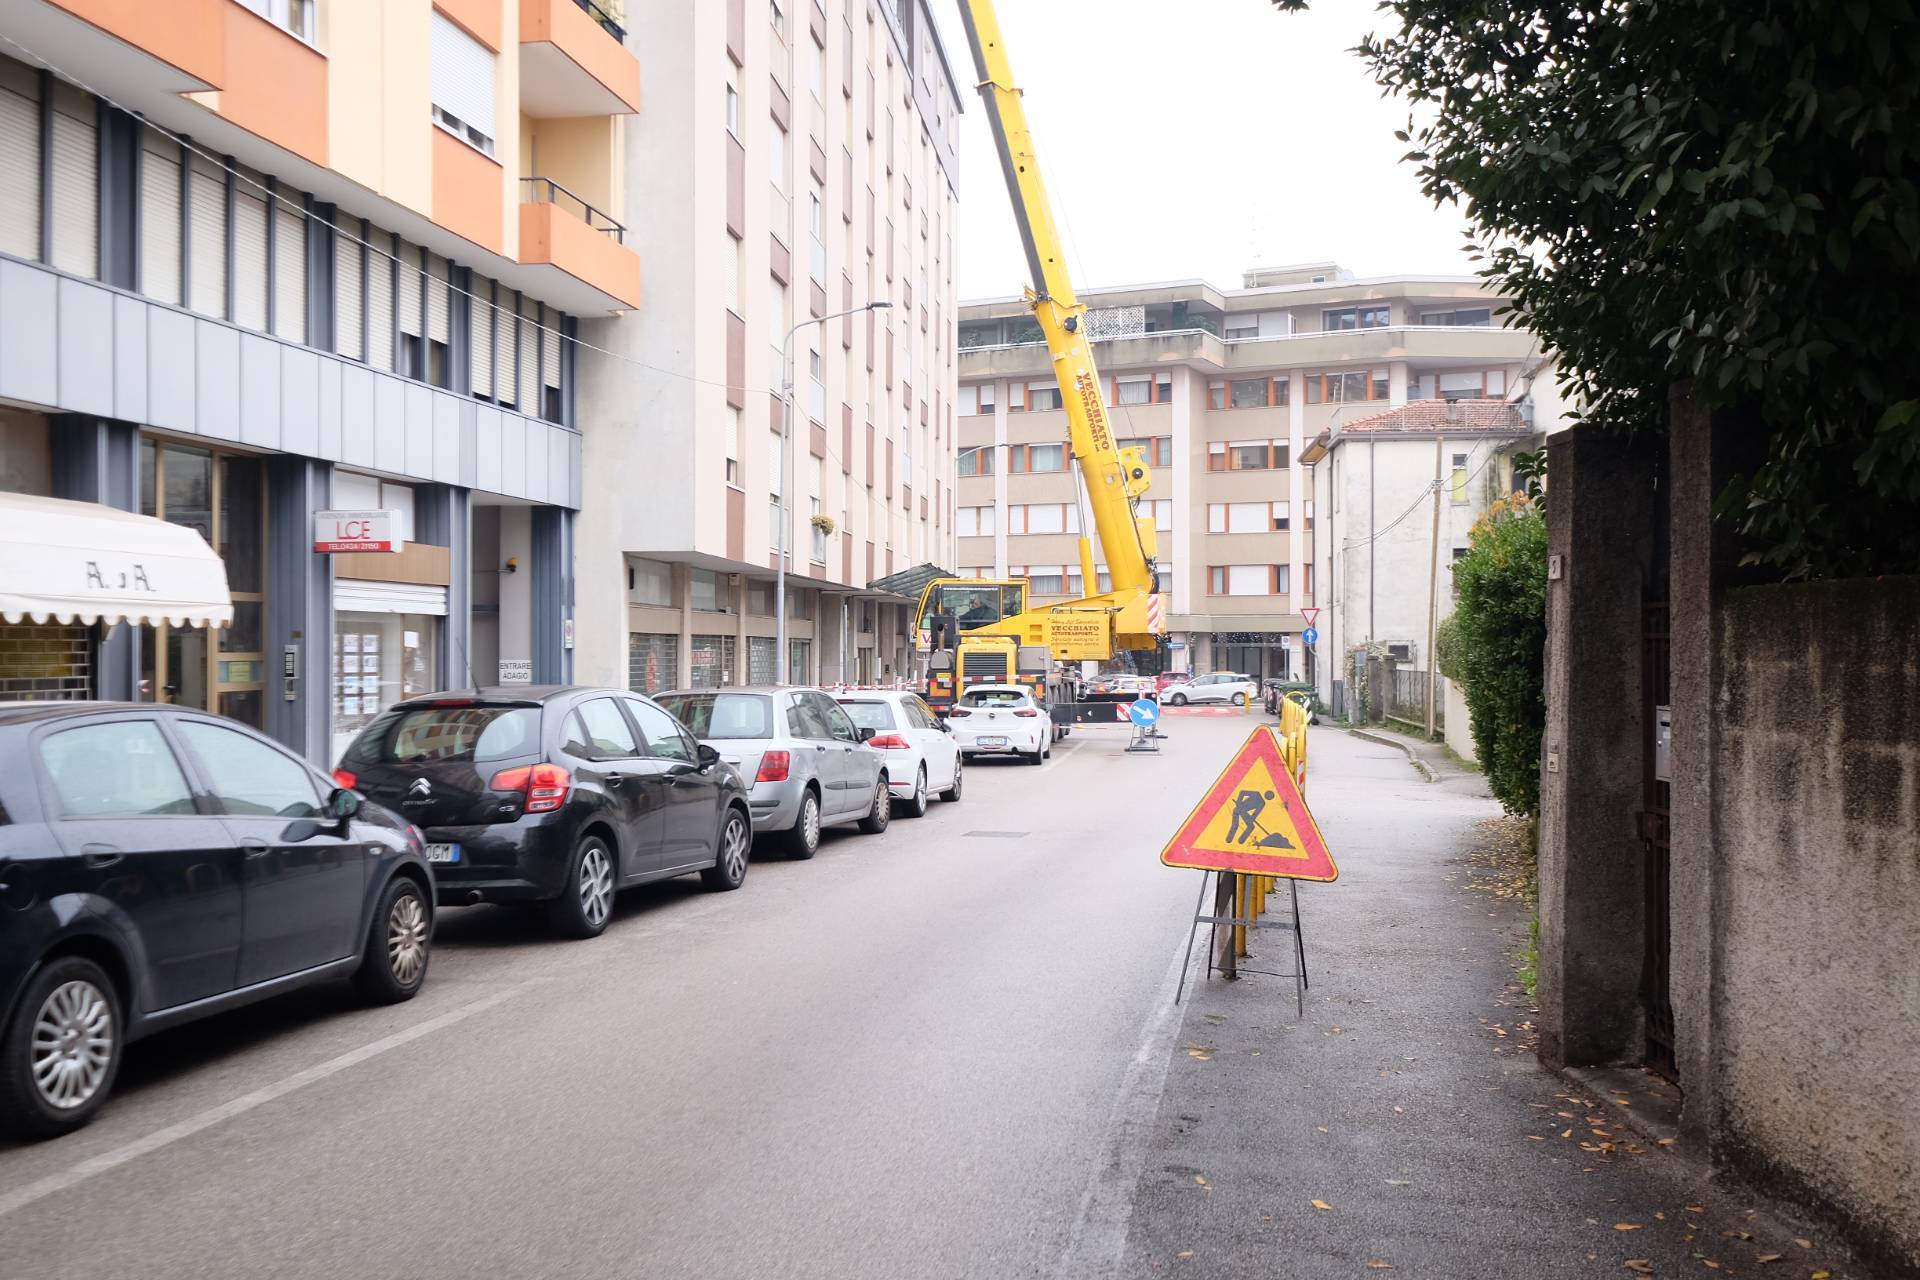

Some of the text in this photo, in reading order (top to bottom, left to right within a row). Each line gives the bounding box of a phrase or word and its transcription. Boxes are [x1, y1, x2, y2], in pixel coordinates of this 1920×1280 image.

[1076, 375, 1099, 442] AUTOTRASPORTI
[1083, 372, 1109, 450] VECCHIATO
[336, 520, 370, 540] LCE
[499, 662, 534, 670] ENTRARE
[502, 672, 529, 680] ADAGIO
